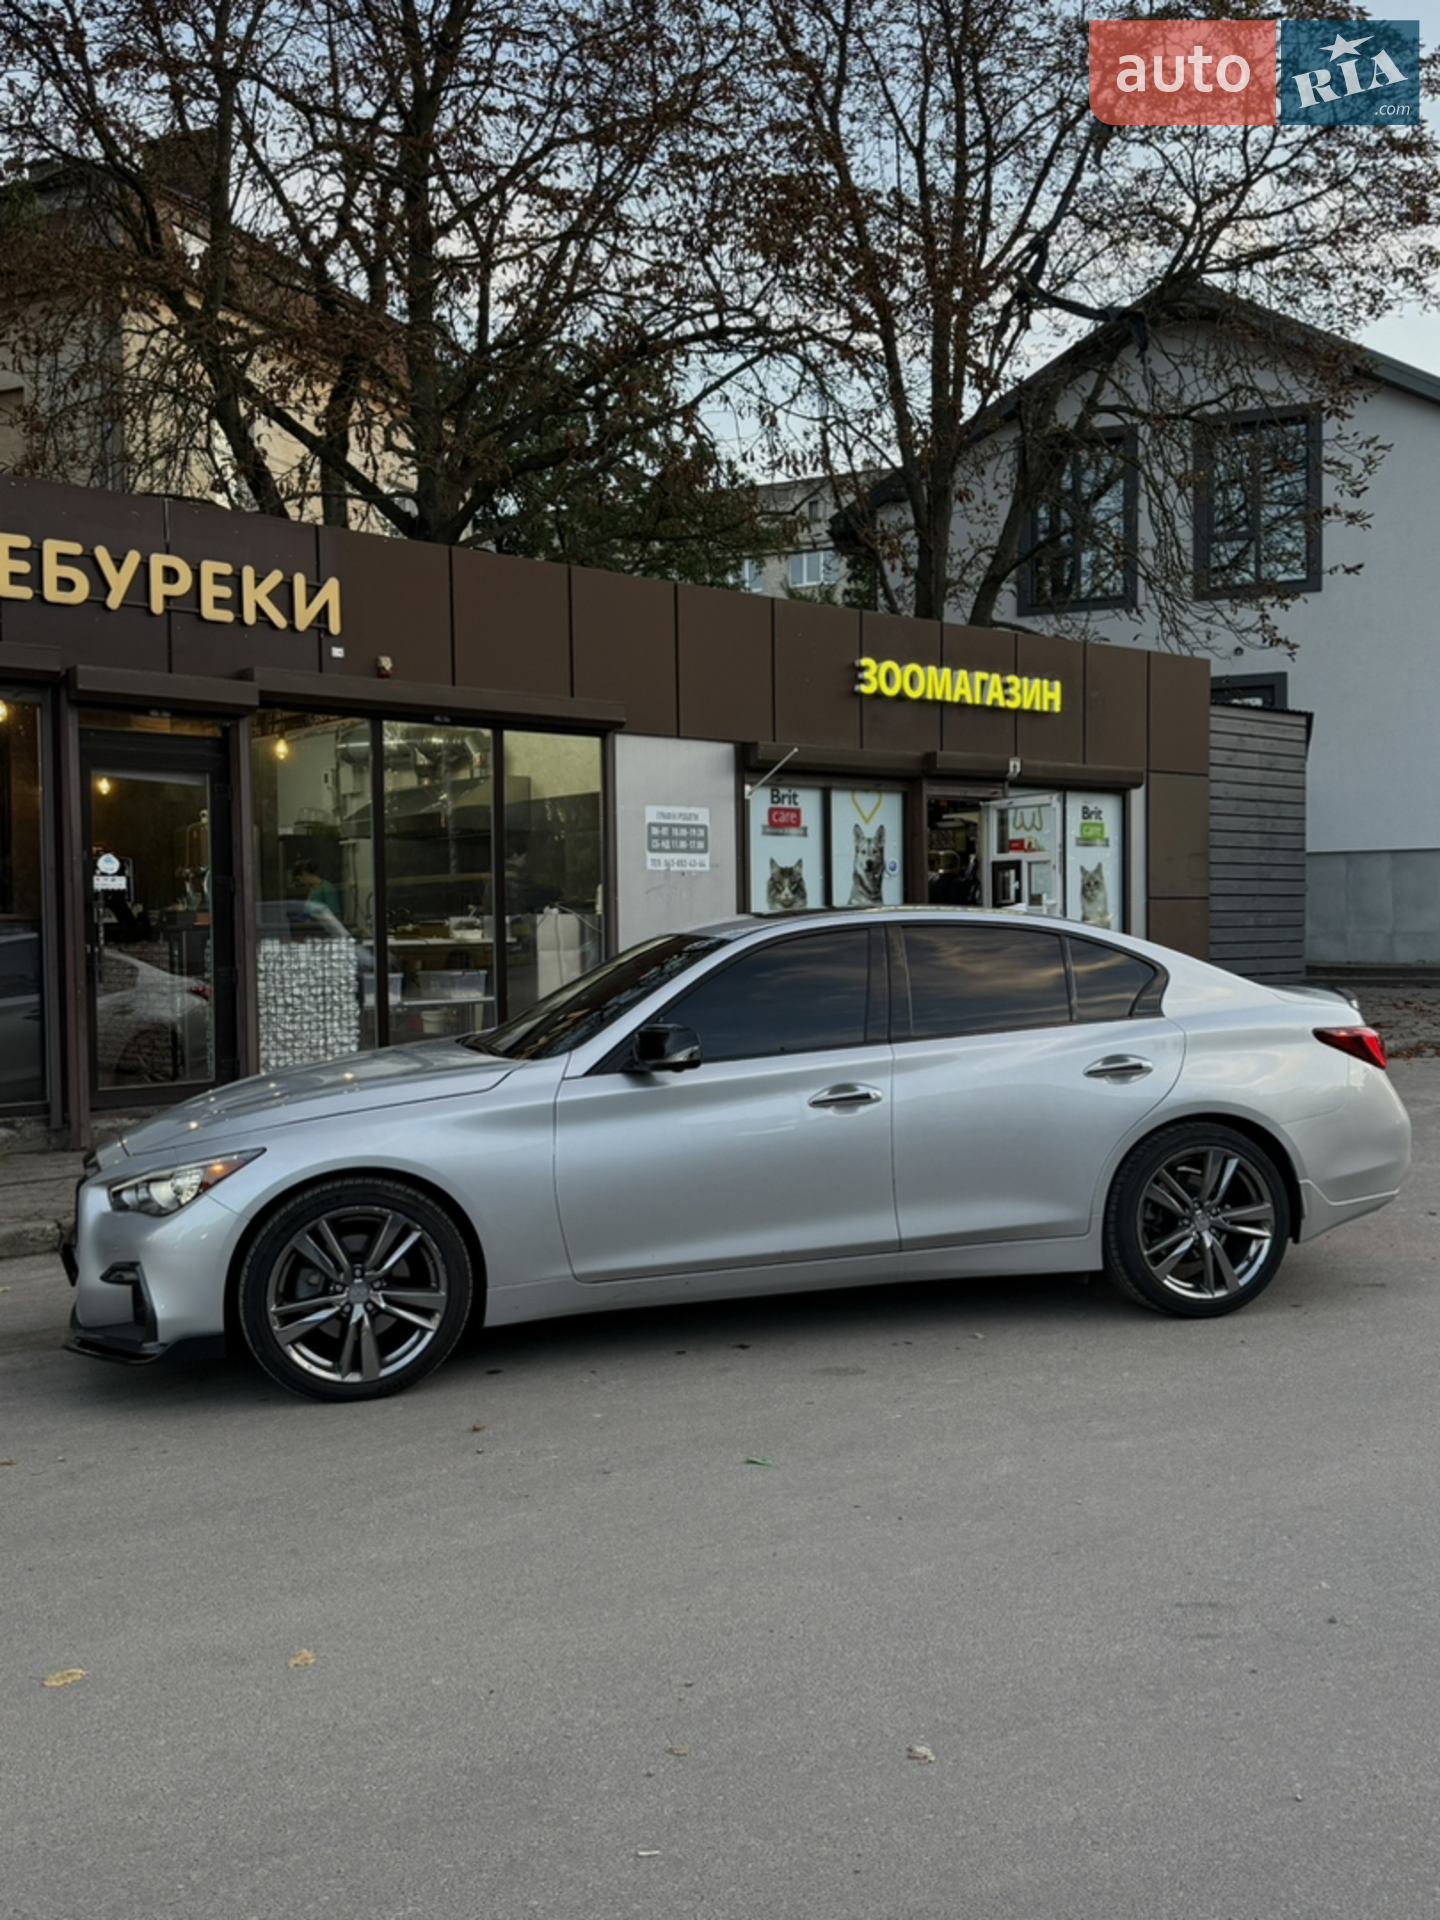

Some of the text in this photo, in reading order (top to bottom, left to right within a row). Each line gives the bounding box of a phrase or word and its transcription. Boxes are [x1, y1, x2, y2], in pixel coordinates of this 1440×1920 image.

[0, 532, 341, 635] ЕБУРЕКИ
[855, 657, 1061, 713] ЗООМАГАЗИН
[770, 788, 799, 806] Brit
[772, 810, 798, 824] care
[1081, 805, 1103, 821] Brit
